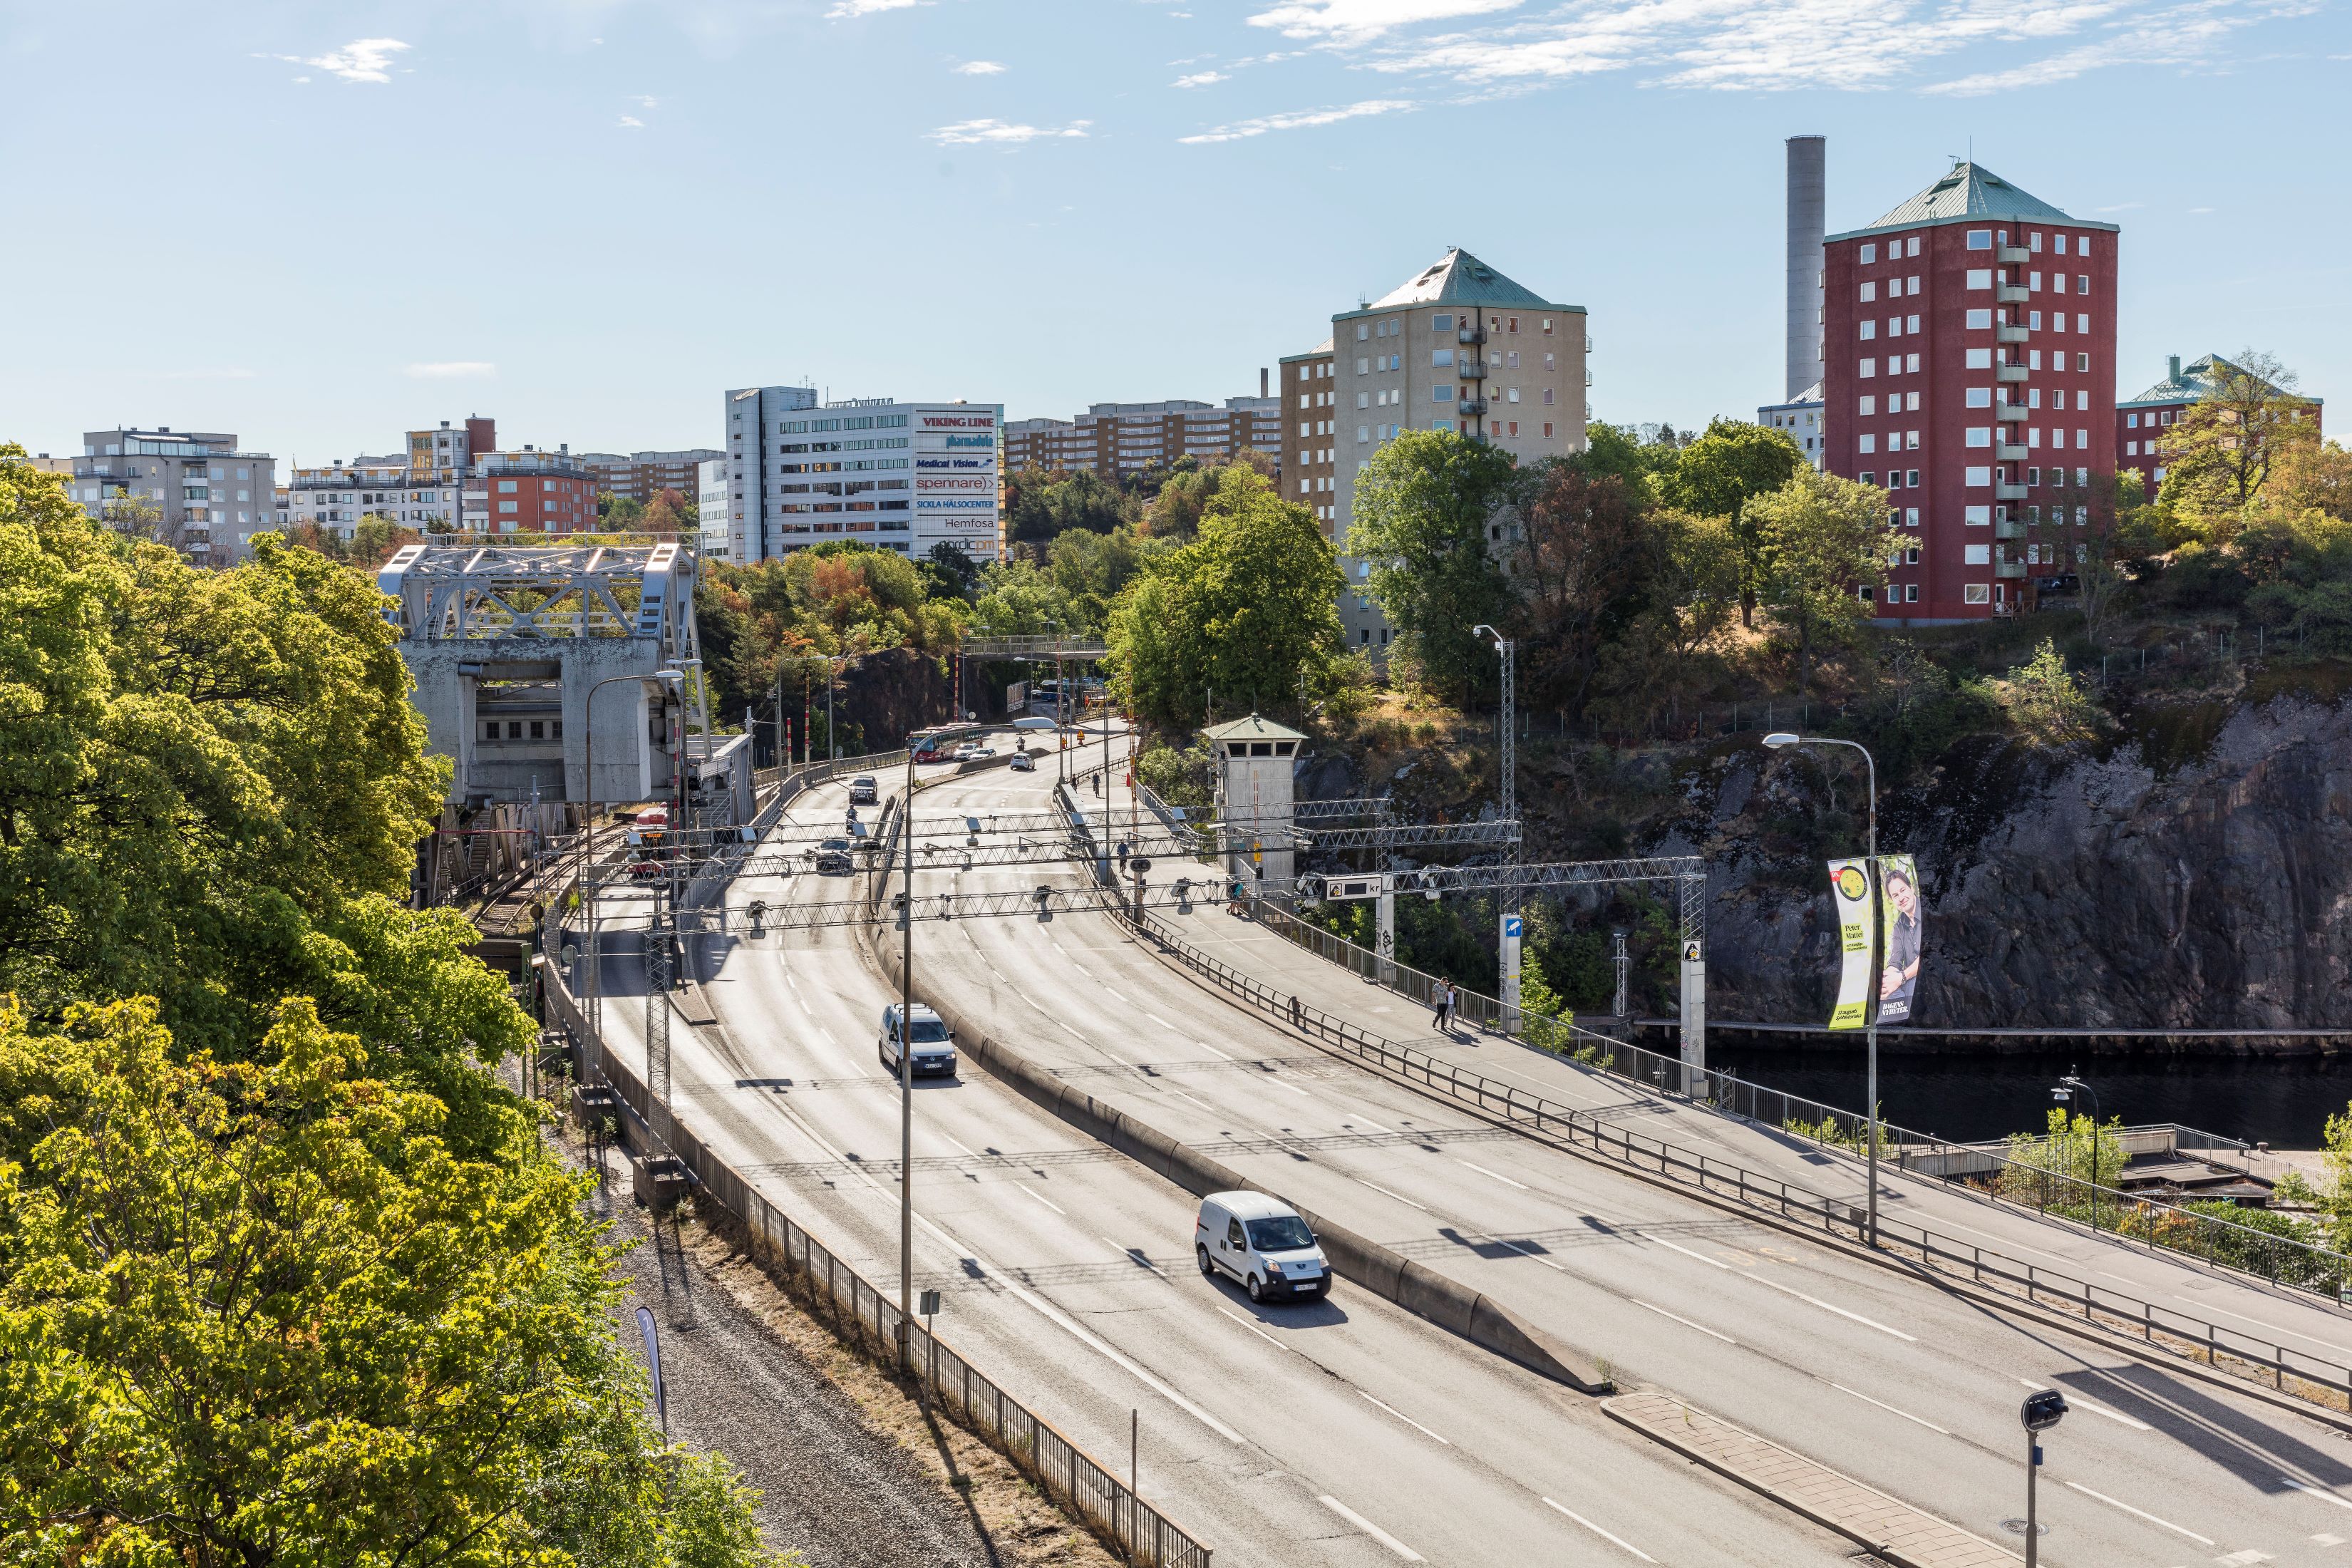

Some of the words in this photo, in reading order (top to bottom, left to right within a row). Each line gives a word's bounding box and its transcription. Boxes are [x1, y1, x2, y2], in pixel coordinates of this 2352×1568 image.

[922, 417, 966, 427] VIKING
[968, 418, 994, 427] LINE
[946, 434, 993, 449] pharmadule
[916, 459, 949, 468] Medical
[953, 459, 979, 468] Vision
[943, 499, 994, 508] HÄLSOCENTER
[945, 518, 994, 528] Hemfosa
[1369, 884, 1379, 892] kr
[1846, 931, 1863, 939] Mattei
[1882, 1001, 1904, 1010] DAGENS
